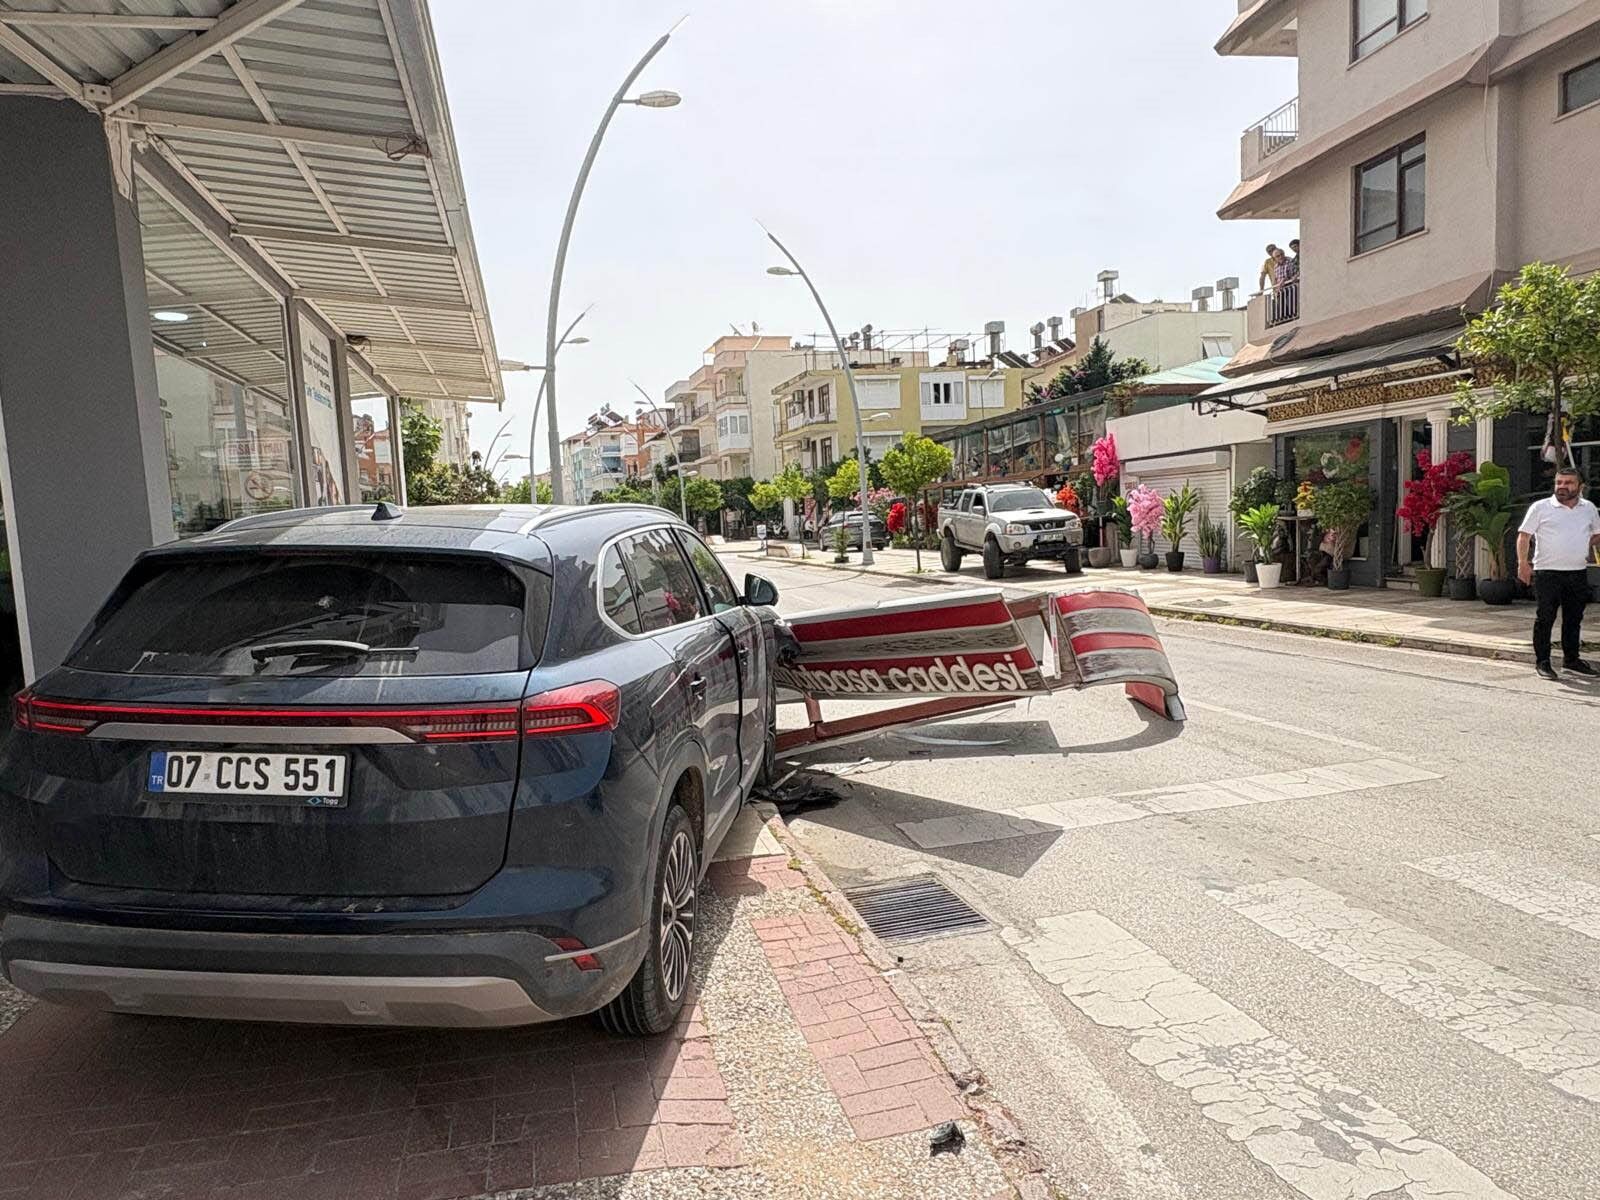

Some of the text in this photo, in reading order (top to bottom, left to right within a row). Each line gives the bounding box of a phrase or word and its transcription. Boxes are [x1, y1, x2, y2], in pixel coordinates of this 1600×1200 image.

[887, 653, 1029, 693] caddesi
[151, 774, 164, 786] TR
[166, 755, 337, 792] 07 CCS 551
[322, 797, 339, 806] Togg
